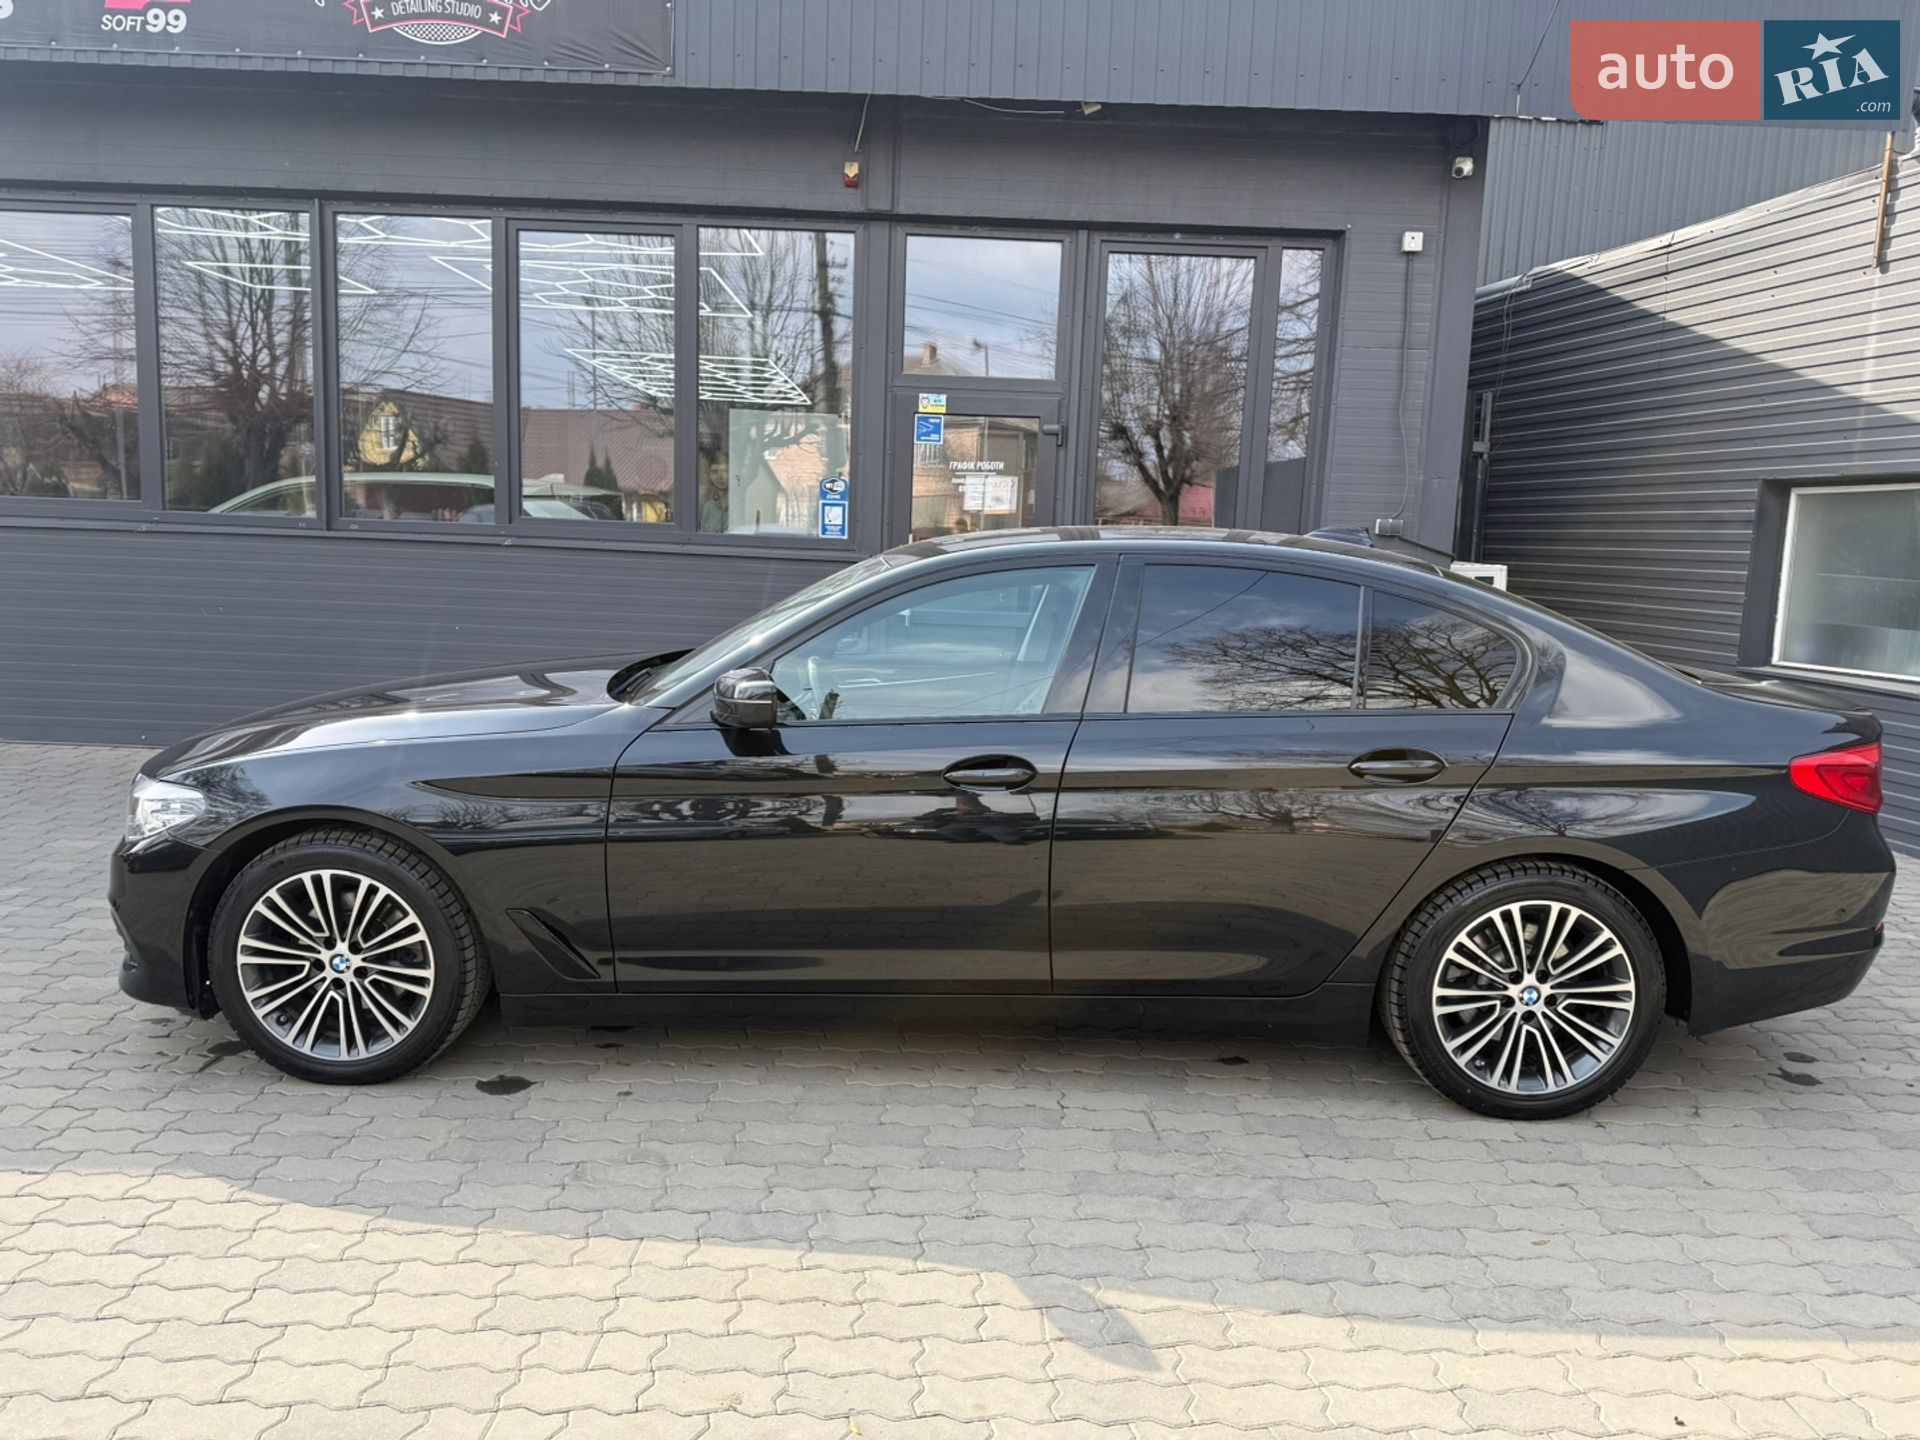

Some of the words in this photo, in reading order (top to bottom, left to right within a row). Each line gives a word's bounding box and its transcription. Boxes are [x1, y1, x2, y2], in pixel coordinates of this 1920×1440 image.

[390, 0, 442, 16] DETAILING
[444, 1, 482, 19] STUDIO
[101, 8, 187, 34] SOFT99
[949, 461, 976, 470] ГРАФІК
[976, 461, 1005, 471] РОБОТИ
